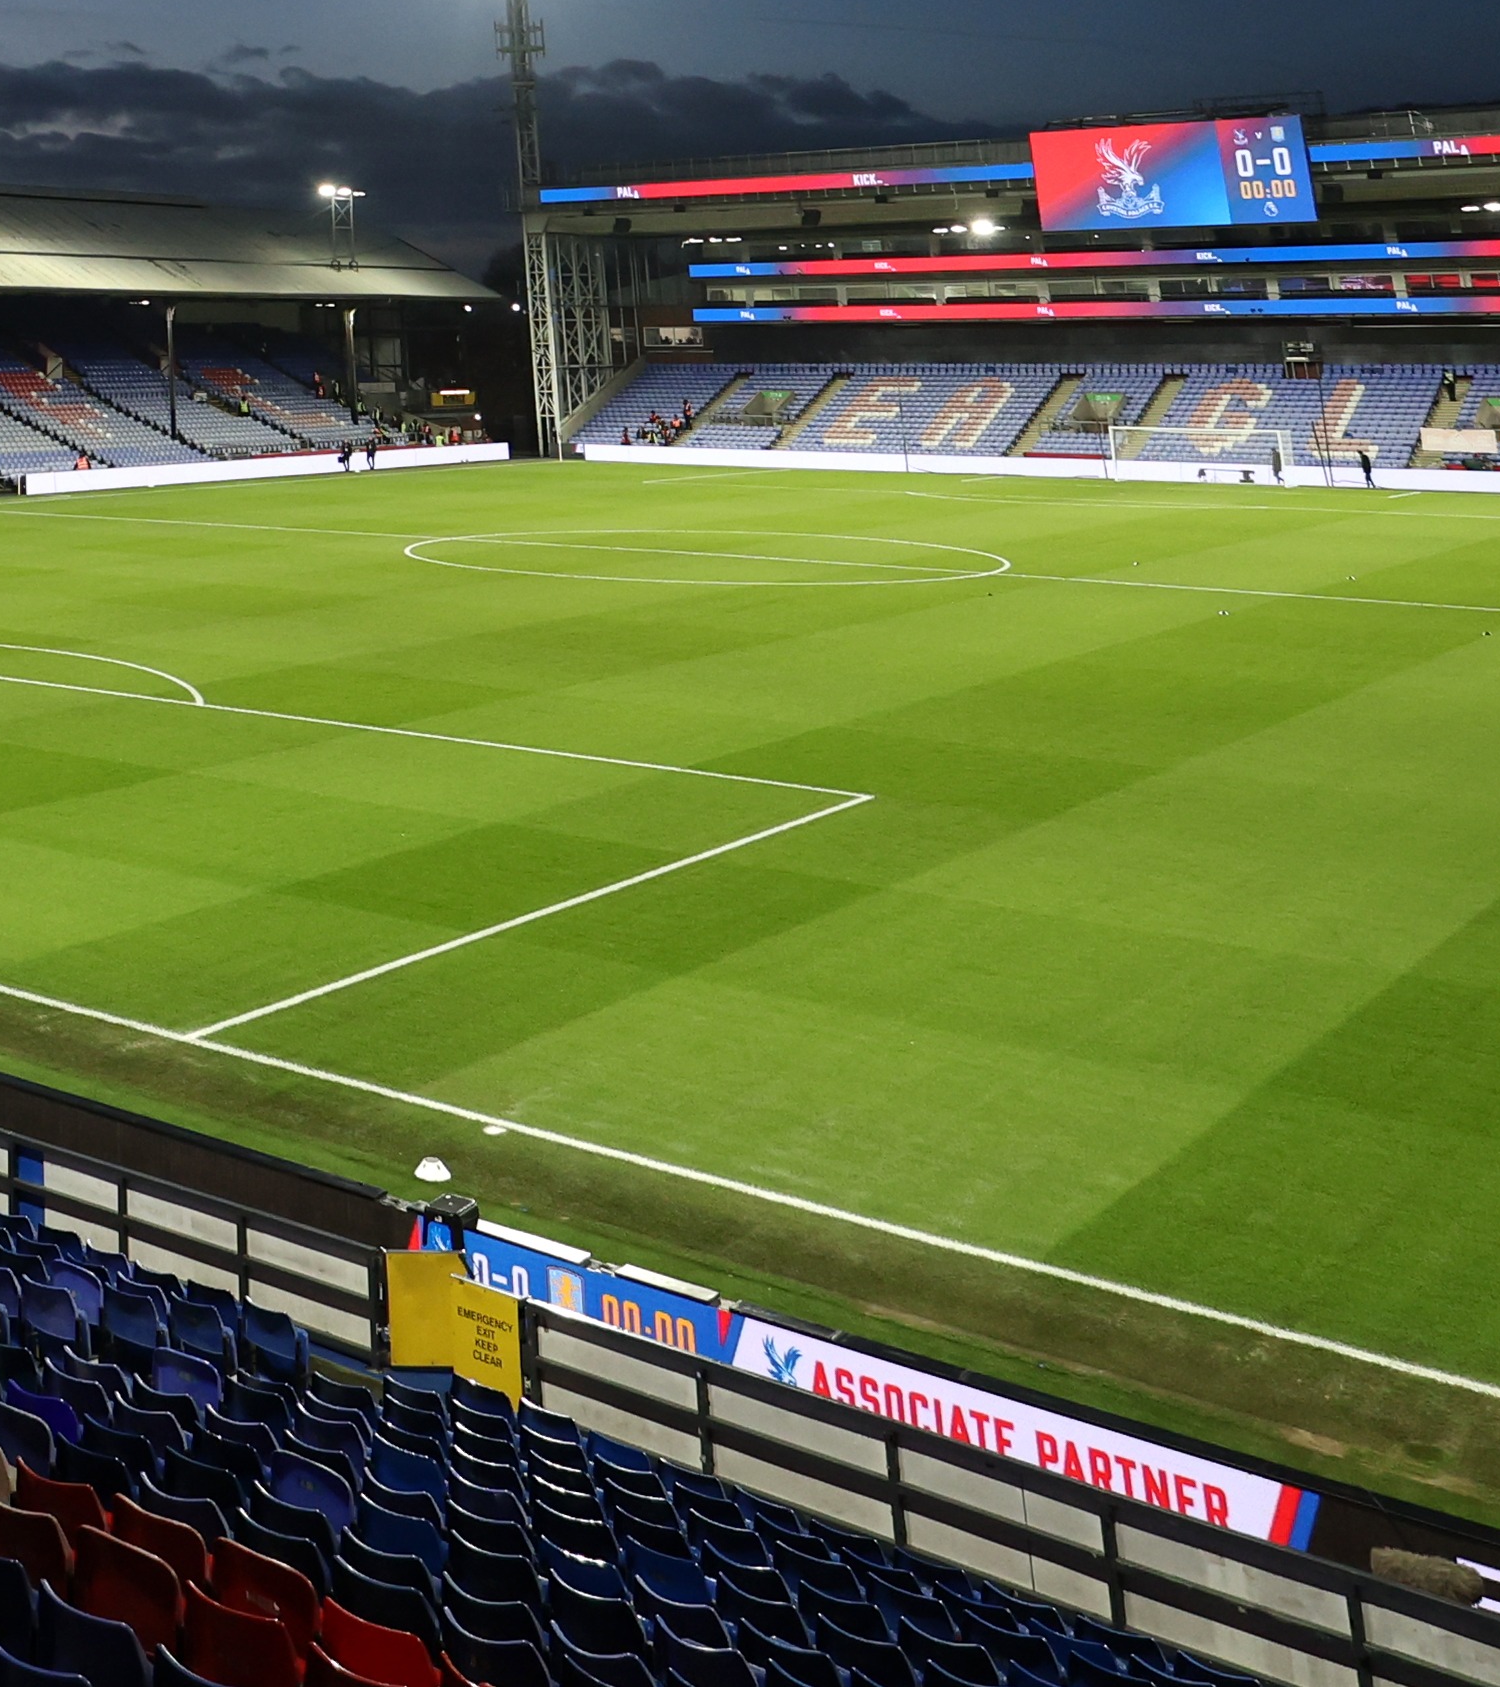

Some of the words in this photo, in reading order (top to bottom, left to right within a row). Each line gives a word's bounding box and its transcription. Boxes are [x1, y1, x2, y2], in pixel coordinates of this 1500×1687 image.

[1235, 147, 1292, 178] 0-0
[1239, 179, 1297, 200] 00:00
[457, 1305, 514, 1334] EMERGENCY
[476, 1324, 496, 1341] EXIT
[474, 1337, 499, 1354] KEEP
[472, 1348, 503, 1369] CLEAR
[812, 1359, 1016, 1455] ASSOCIATE
[1035, 1429, 1229, 1528] PARTNER
